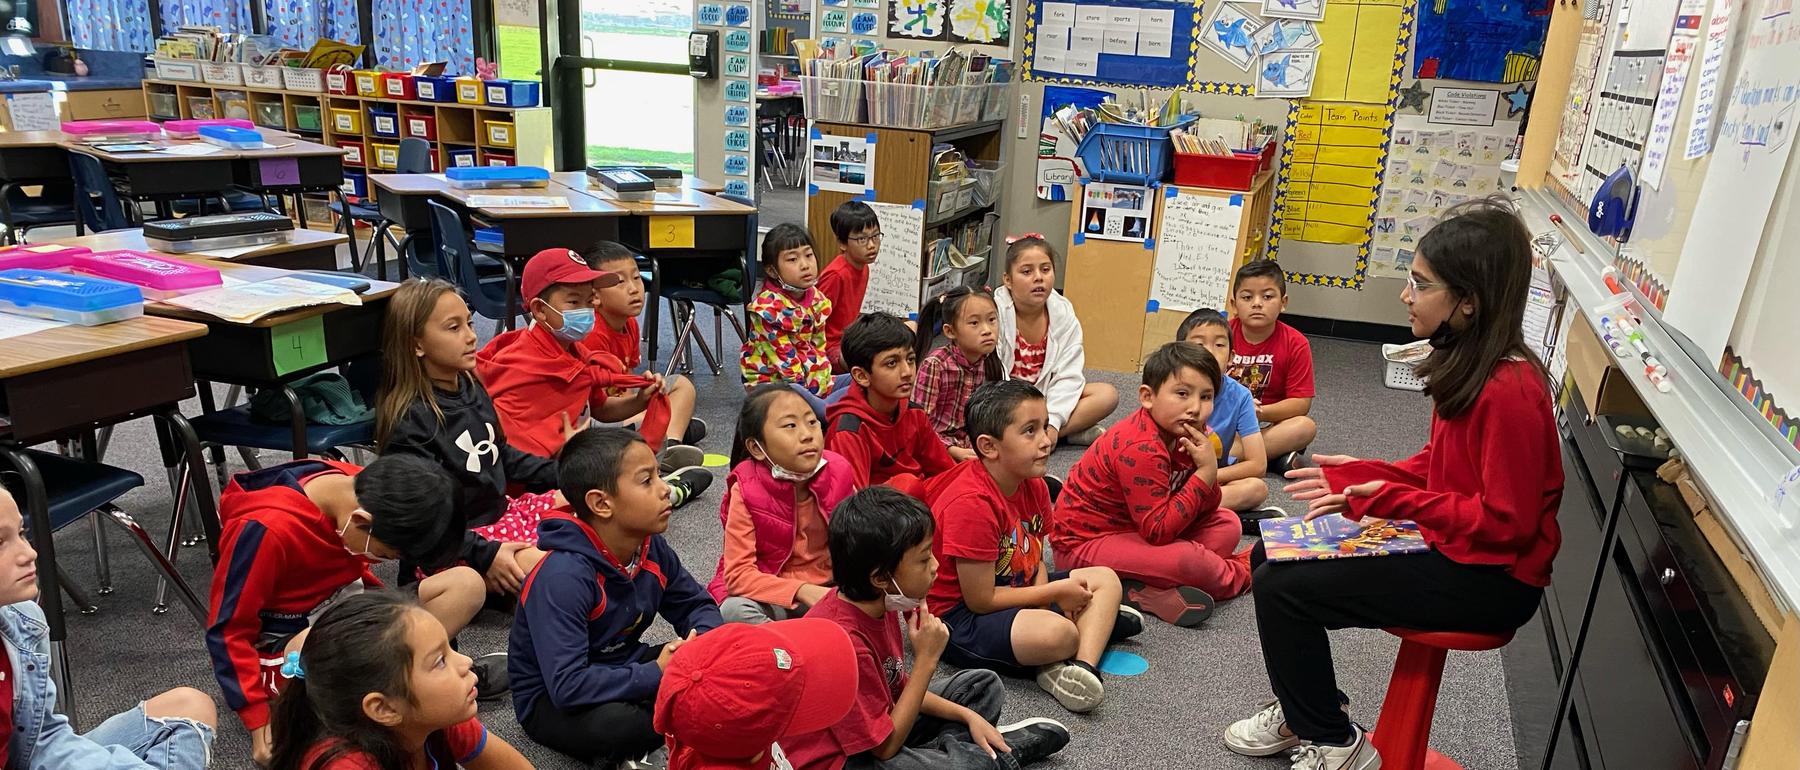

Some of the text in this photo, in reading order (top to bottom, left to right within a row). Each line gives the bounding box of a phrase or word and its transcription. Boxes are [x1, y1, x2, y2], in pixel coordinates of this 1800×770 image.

[1326, 108, 1378, 122] Team Points
[1298, 130, 1312, 139] Red
[274, 163, 286, 179] 6
[1046, 172, 1073, 182] Library
[665, 224, 676, 242] 3
[291, 335, 304, 360] 4
[1232, 354, 1274, 364] OBLOX
